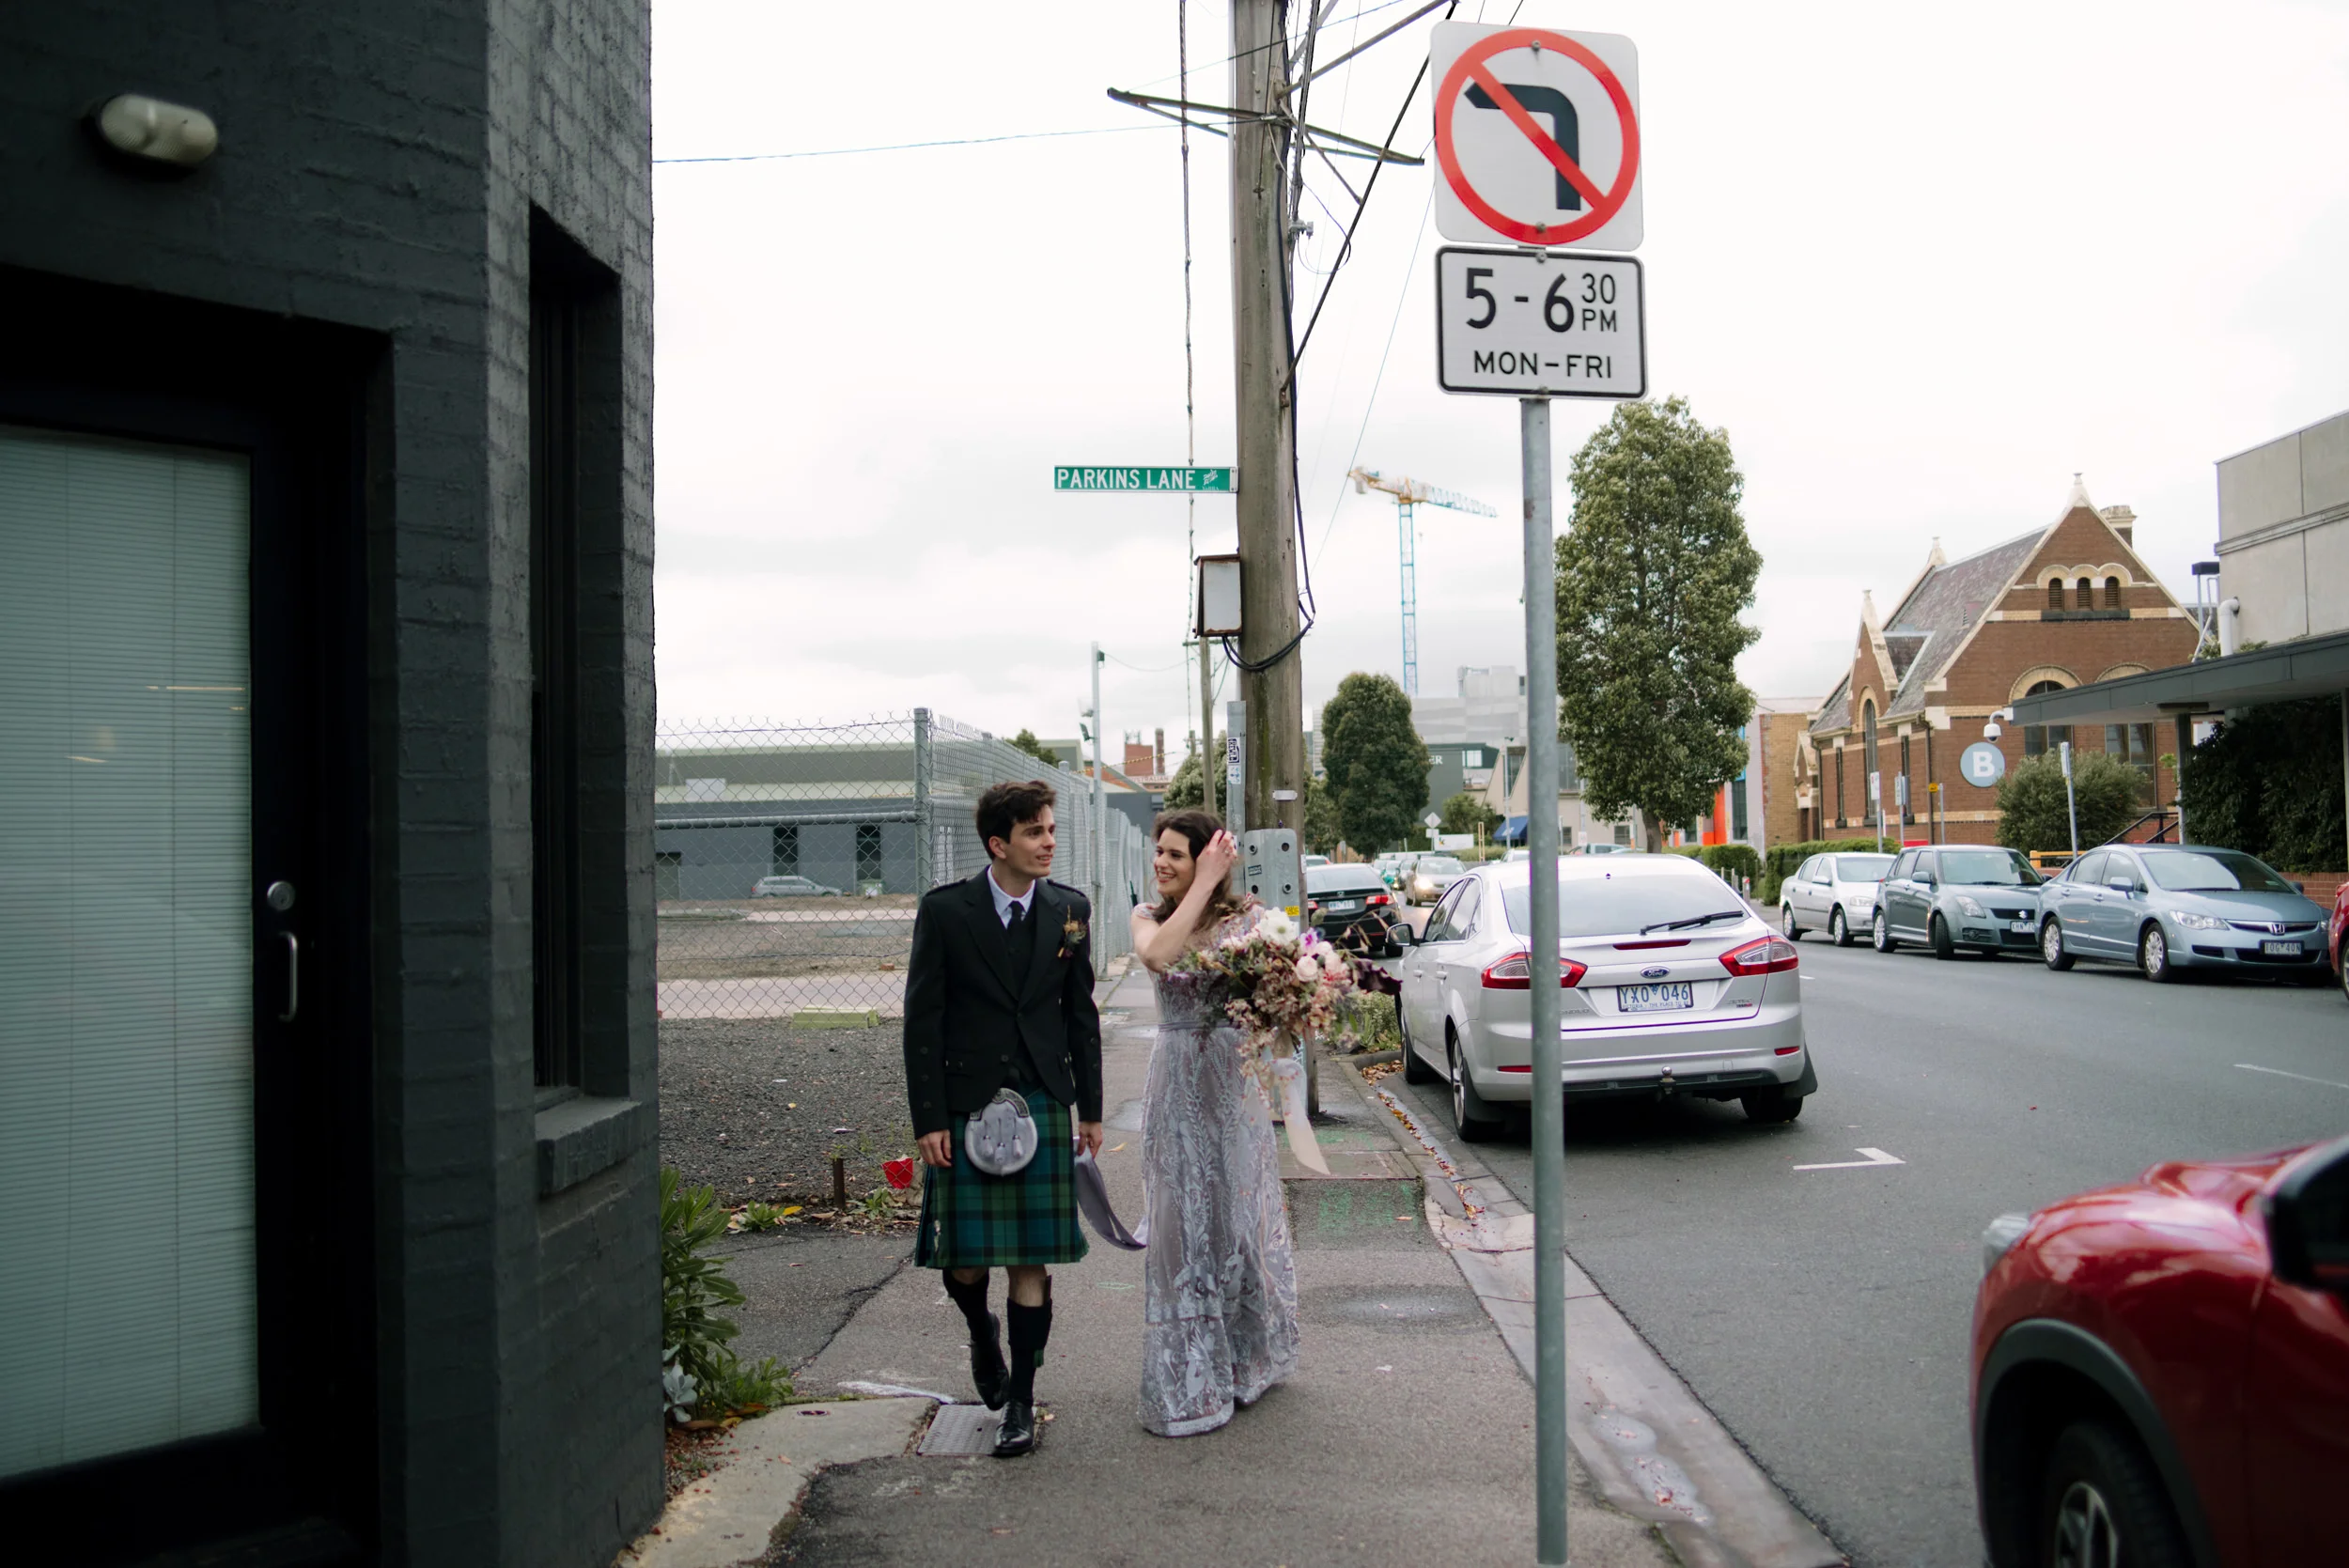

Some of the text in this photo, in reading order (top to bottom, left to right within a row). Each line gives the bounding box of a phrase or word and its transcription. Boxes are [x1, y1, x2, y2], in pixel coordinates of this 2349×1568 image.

[1581, 272, 1616, 304] 30
[1582, 308, 1617, 333] PM
[1056, 468, 1196, 490] PARKINS LANE
[1973, 751, 1996, 778] B
[1661, 984, 1689, 1001] 046
